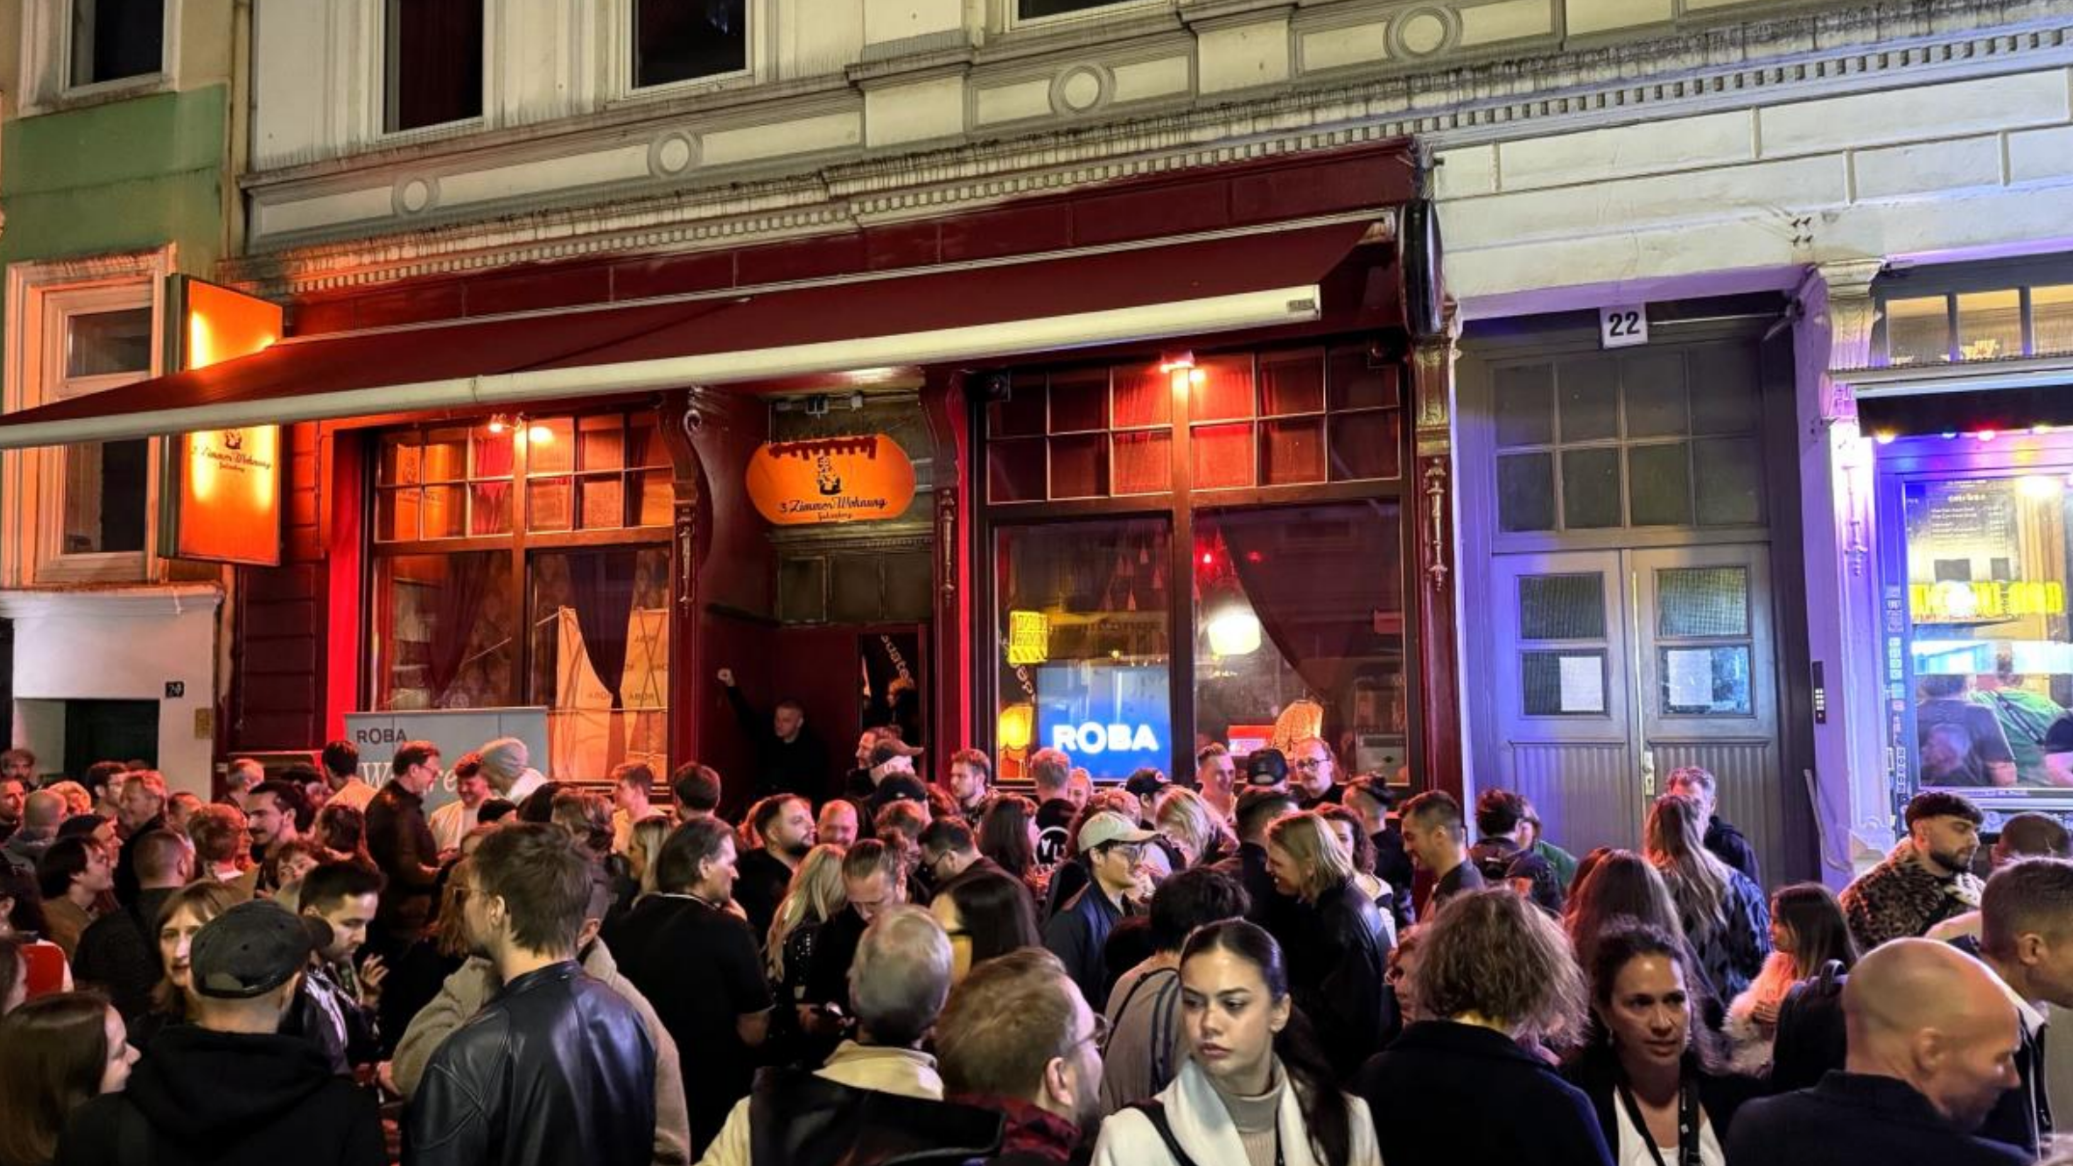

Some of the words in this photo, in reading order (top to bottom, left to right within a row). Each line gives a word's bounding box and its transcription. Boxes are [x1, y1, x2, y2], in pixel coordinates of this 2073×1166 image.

[1609, 311, 1640, 337] 22
[789, 500, 833, 513] Zimmer
[834, 496, 887, 510] Wohnung
[356, 728, 407, 744] ROBA
[1053, 722, 1159, 754] ROBA
[361, 762, 396, 791] W
